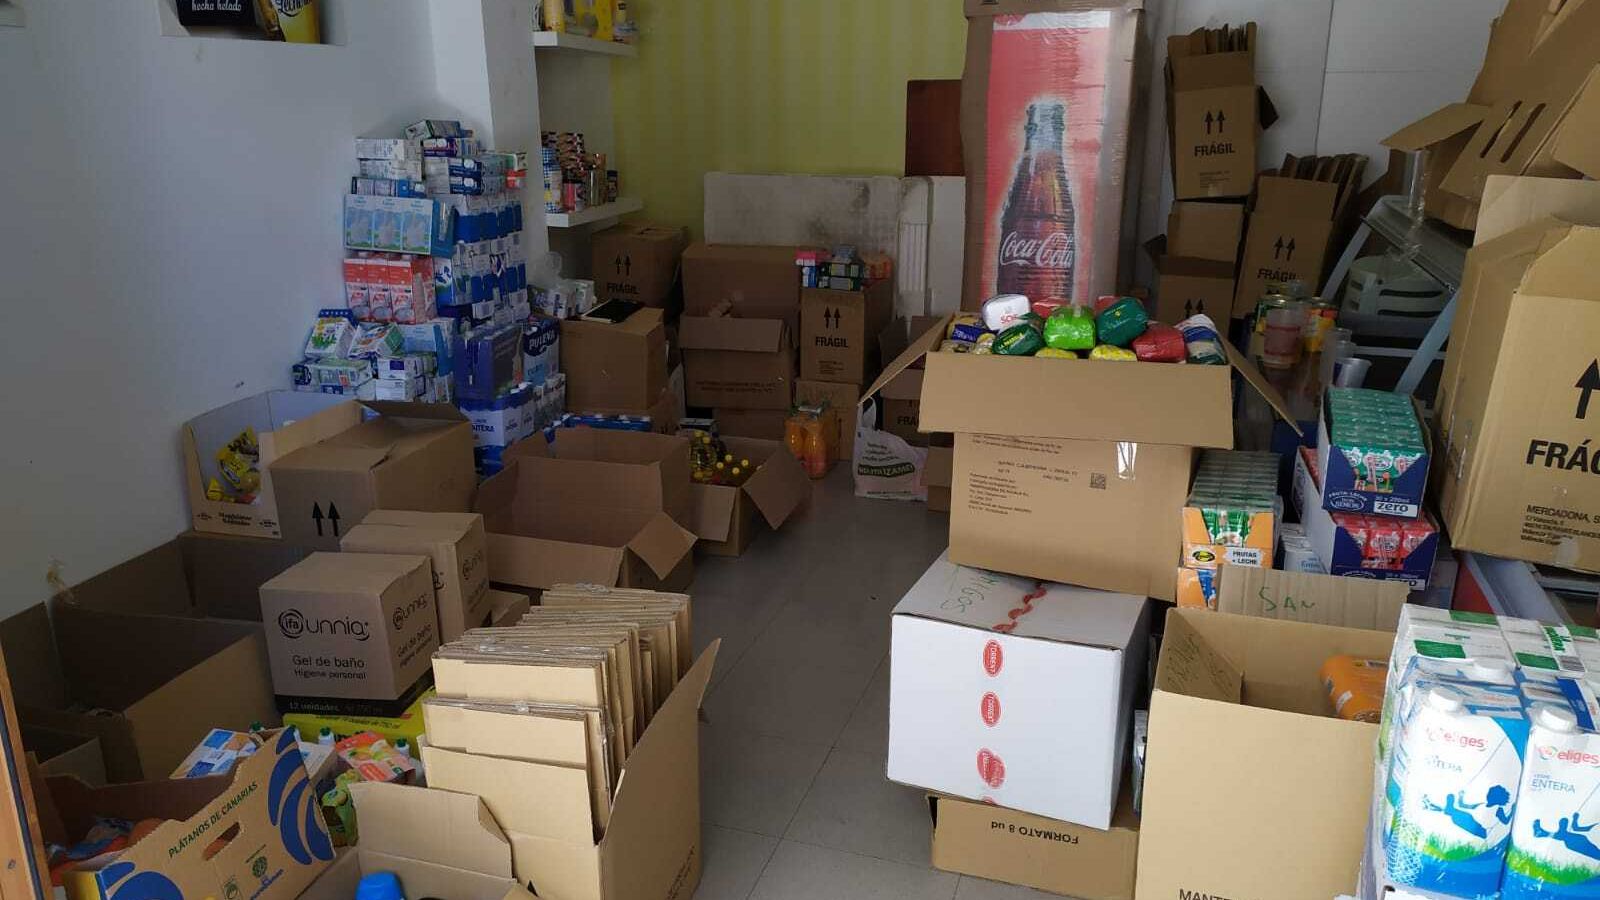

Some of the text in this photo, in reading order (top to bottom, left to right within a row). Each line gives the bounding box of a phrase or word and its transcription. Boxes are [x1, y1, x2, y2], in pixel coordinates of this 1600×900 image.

[1194, 141, 1235, 157] FRÁGIL
[1000, 230, 1073, 268] Coca-Cola
[815, 334, 849, 348] FRÁGIL
[472, 424, 495, 432] NTERA
[1377, 502, 1409, 512] zero
[292, 655, 365, 668] Gel de baño
[1443, 730, 1485, 750] eges
[1557, 747, 1600, 768] eliges
[1531, 777, 1576, 794] ENTERA
[168, 821, 211, 859] PLÁTANOS
[220, 781, 259, 816] CANARIAS
[991, 821, 1079, 845] FORMATO 8 ud
